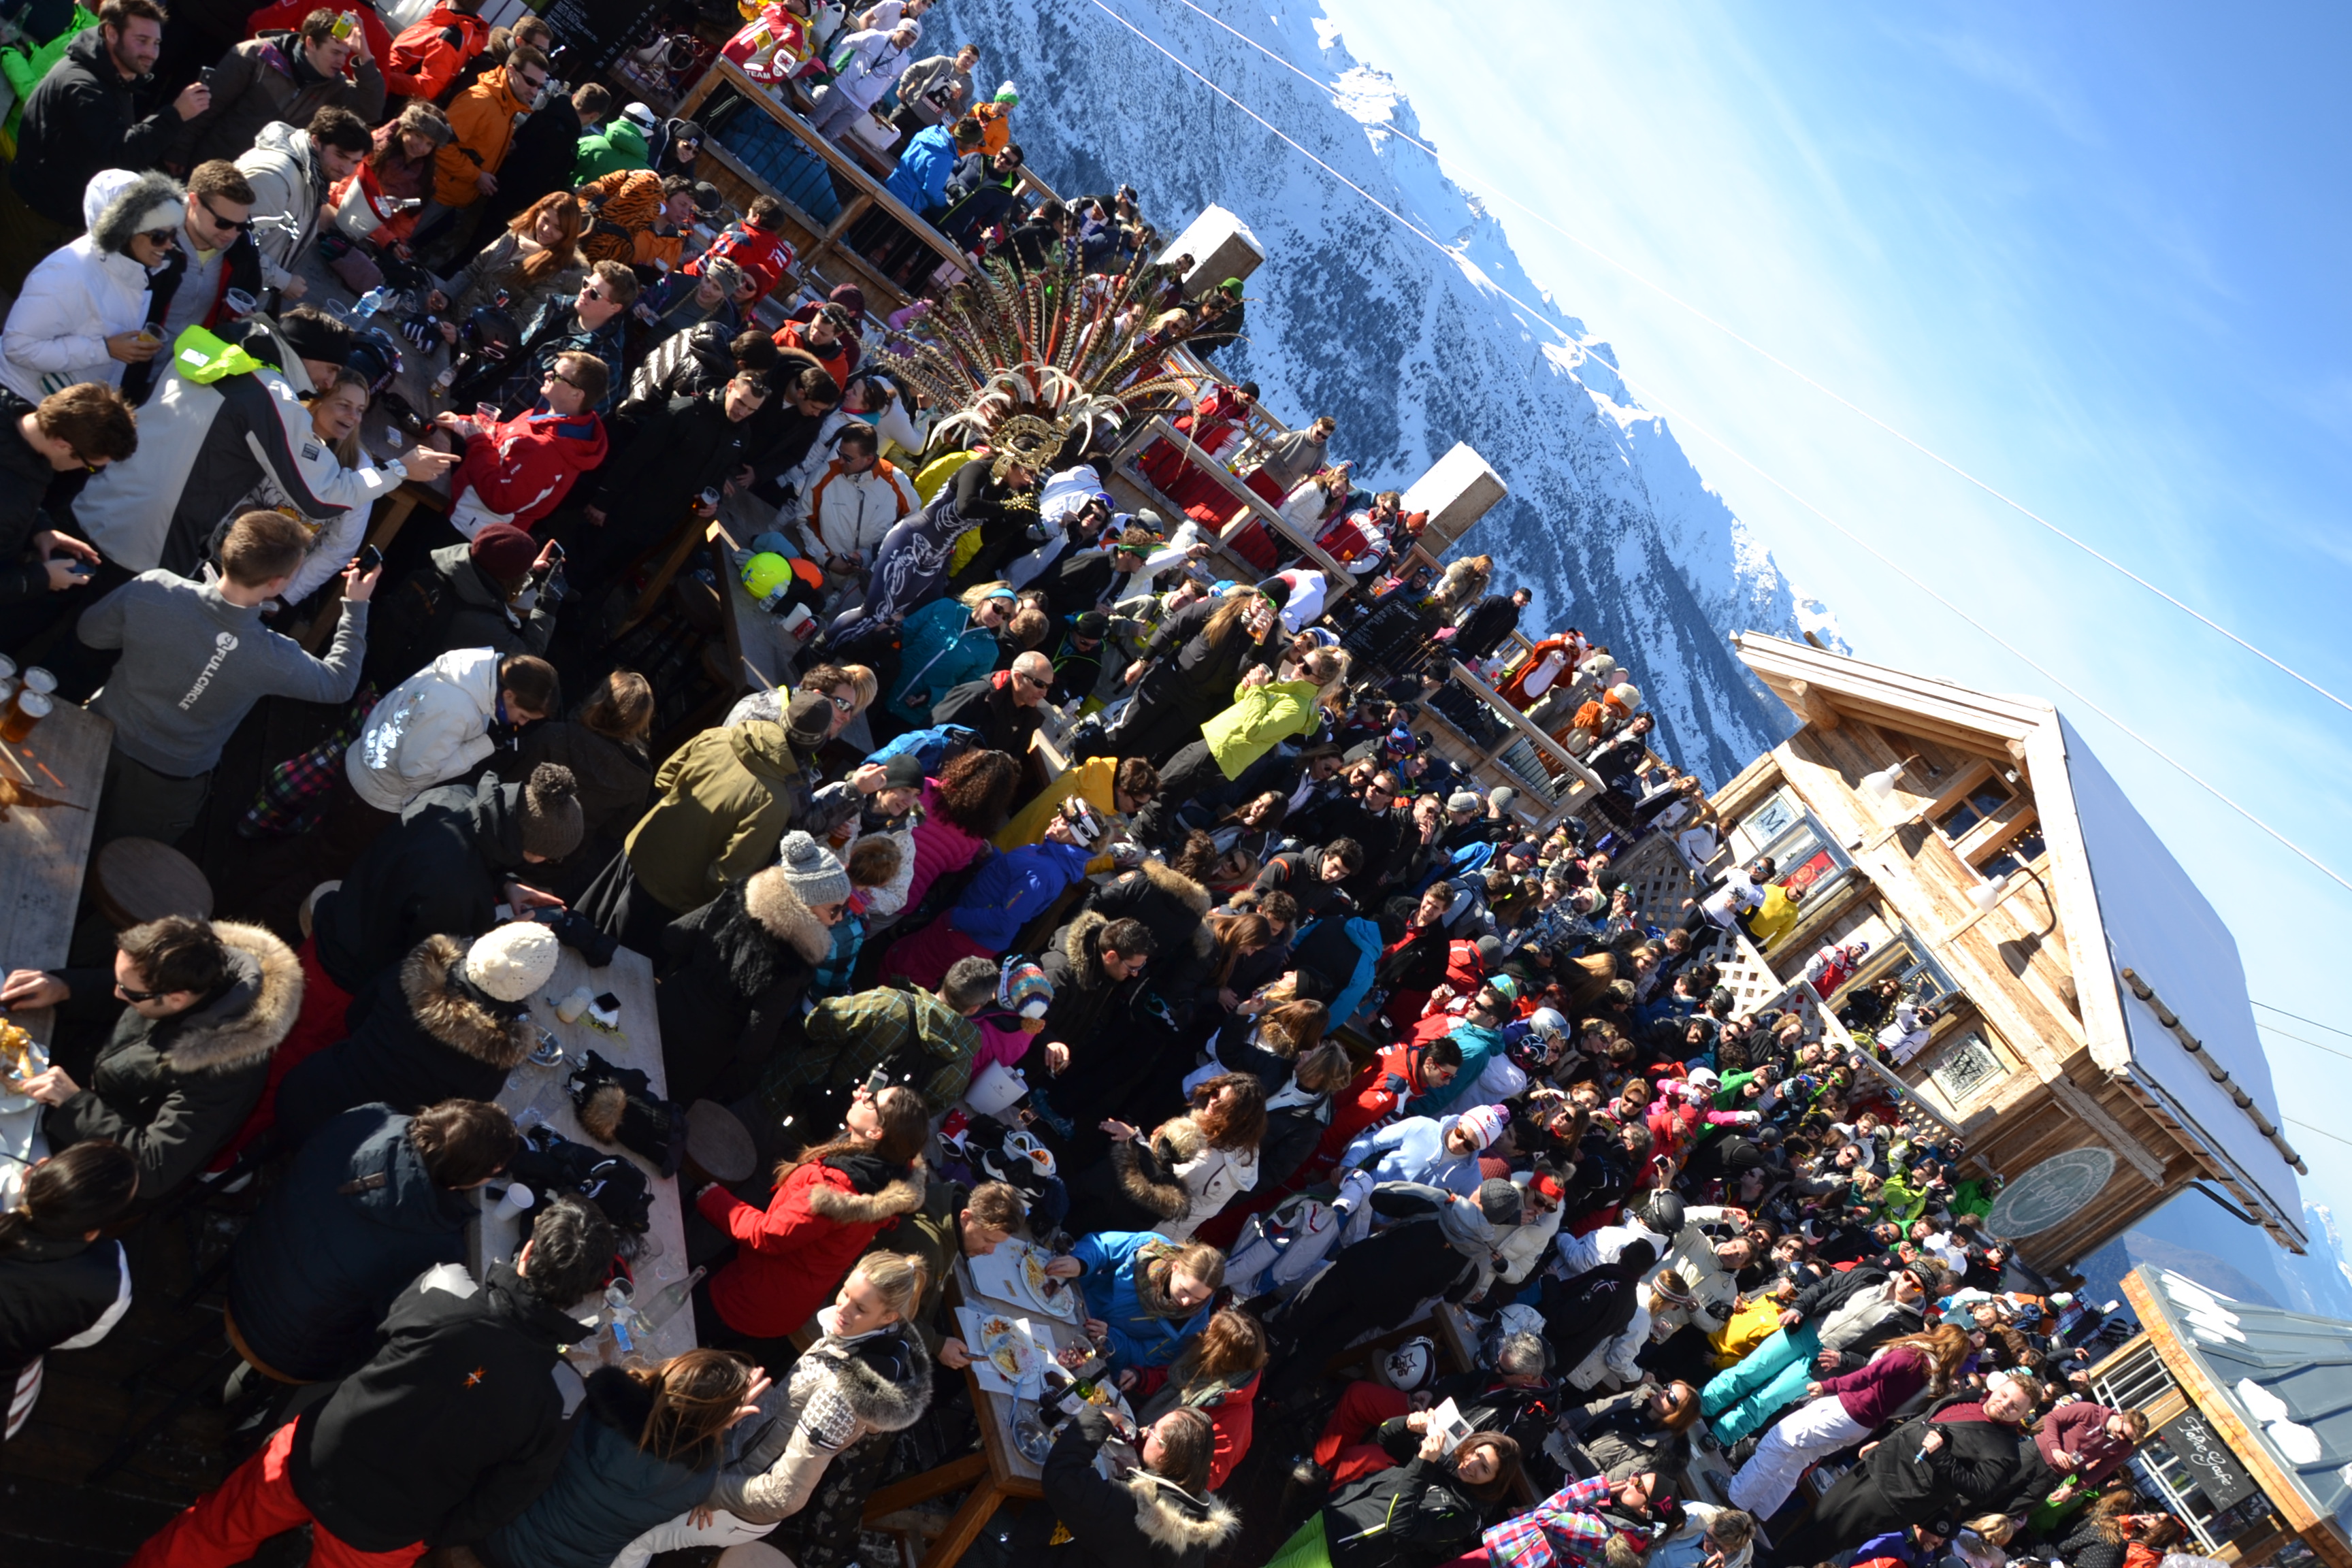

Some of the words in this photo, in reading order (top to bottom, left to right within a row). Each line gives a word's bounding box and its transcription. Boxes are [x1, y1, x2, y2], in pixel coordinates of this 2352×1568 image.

[745, 70, 771, 79] TEAM
[178, 647, 227, 710] FULLCIRCLE
[1760, 808, 1786, 834] M
